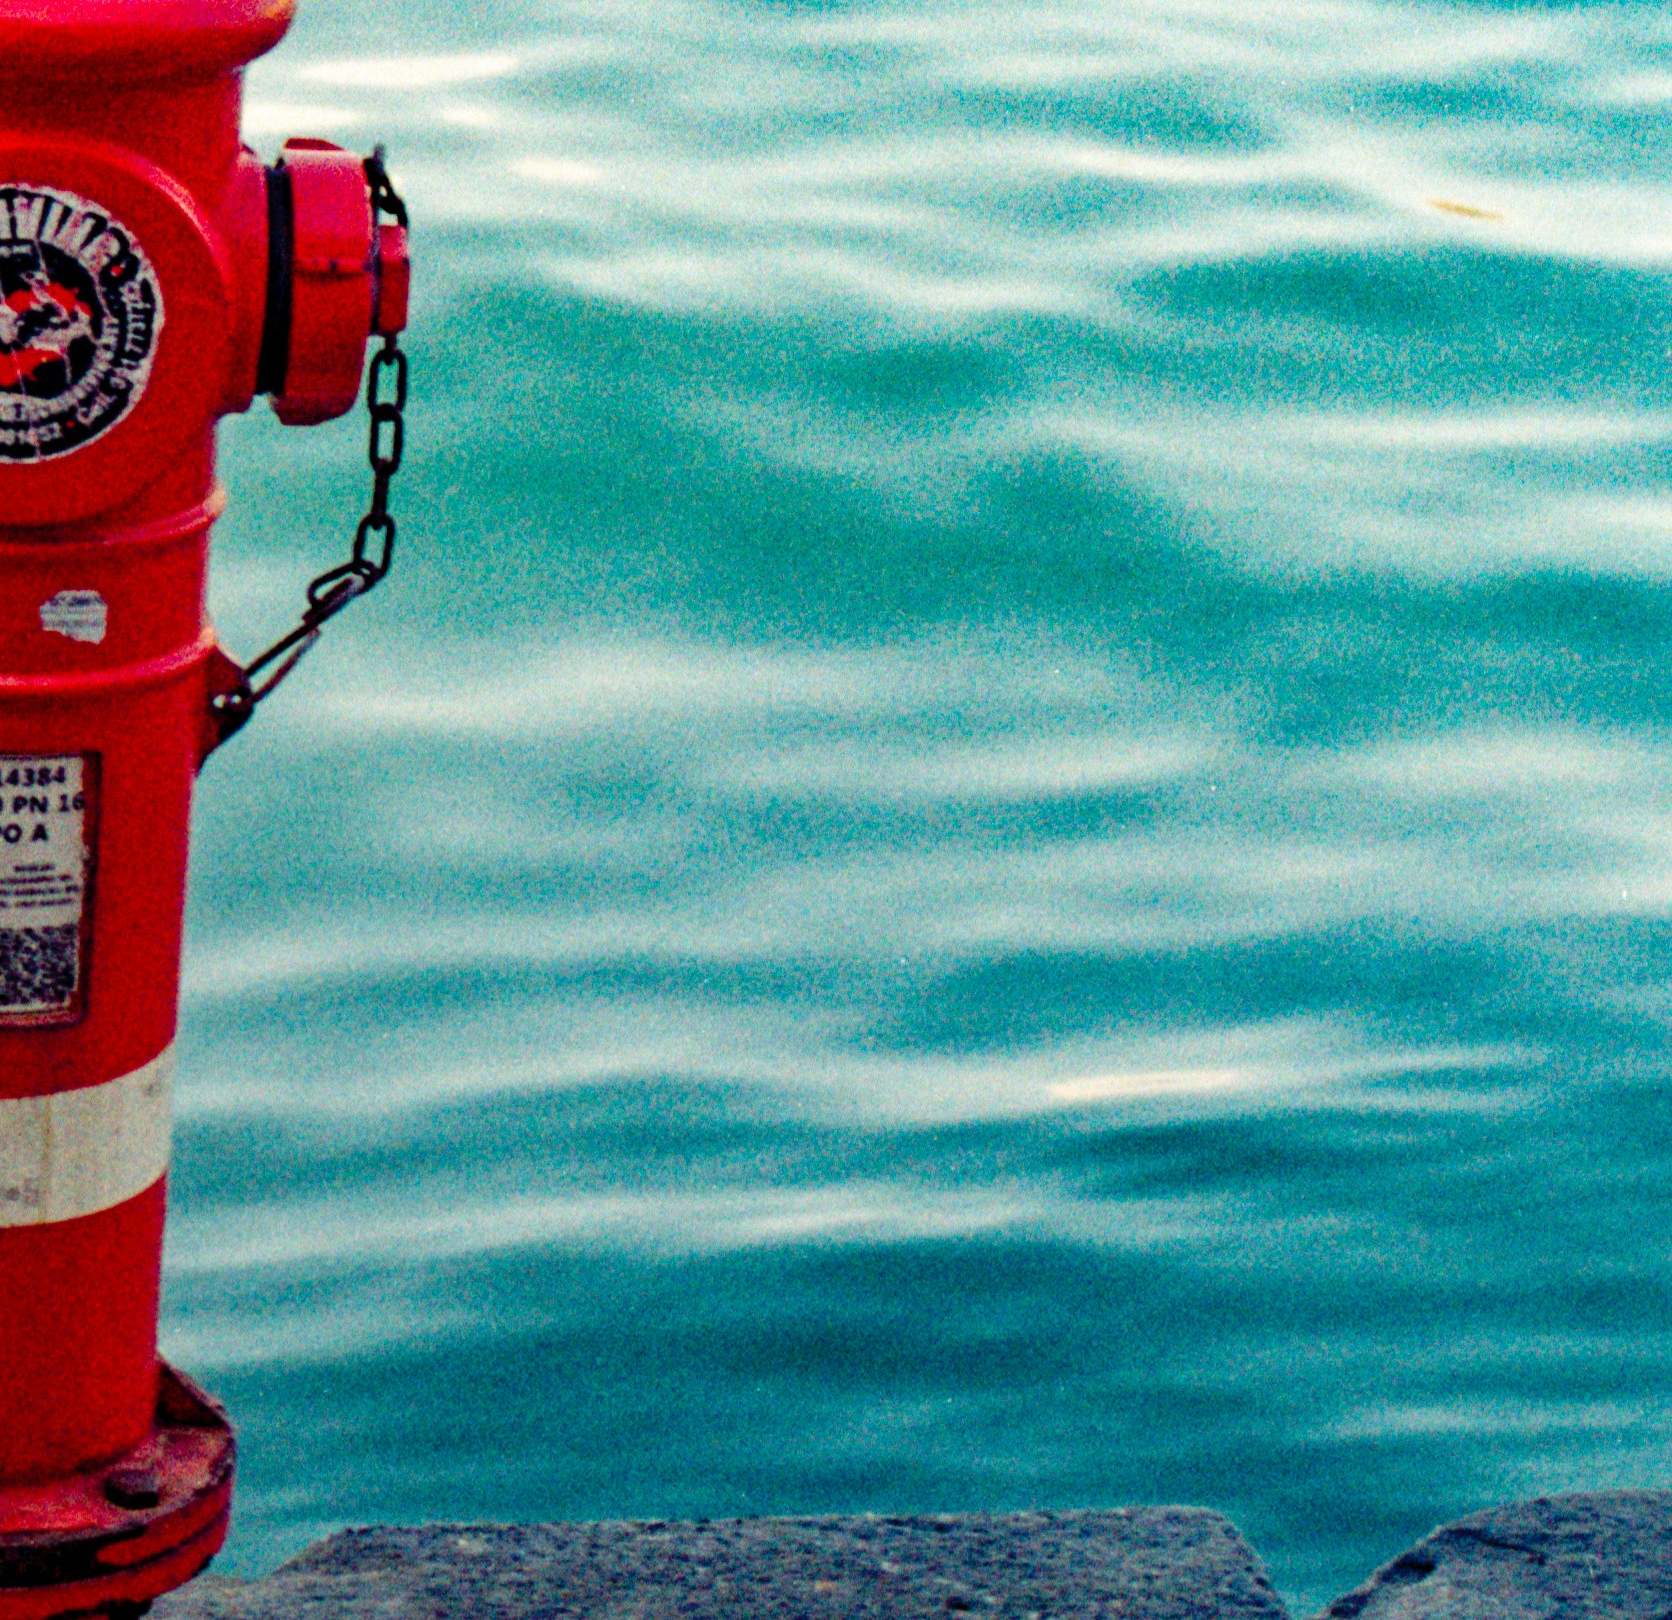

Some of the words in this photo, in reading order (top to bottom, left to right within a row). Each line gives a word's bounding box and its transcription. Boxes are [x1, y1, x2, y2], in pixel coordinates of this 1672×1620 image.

[13, 795, 48, 815] PN
[58, 792, 86, 813] 16
[31, 823, 49, 842] A
